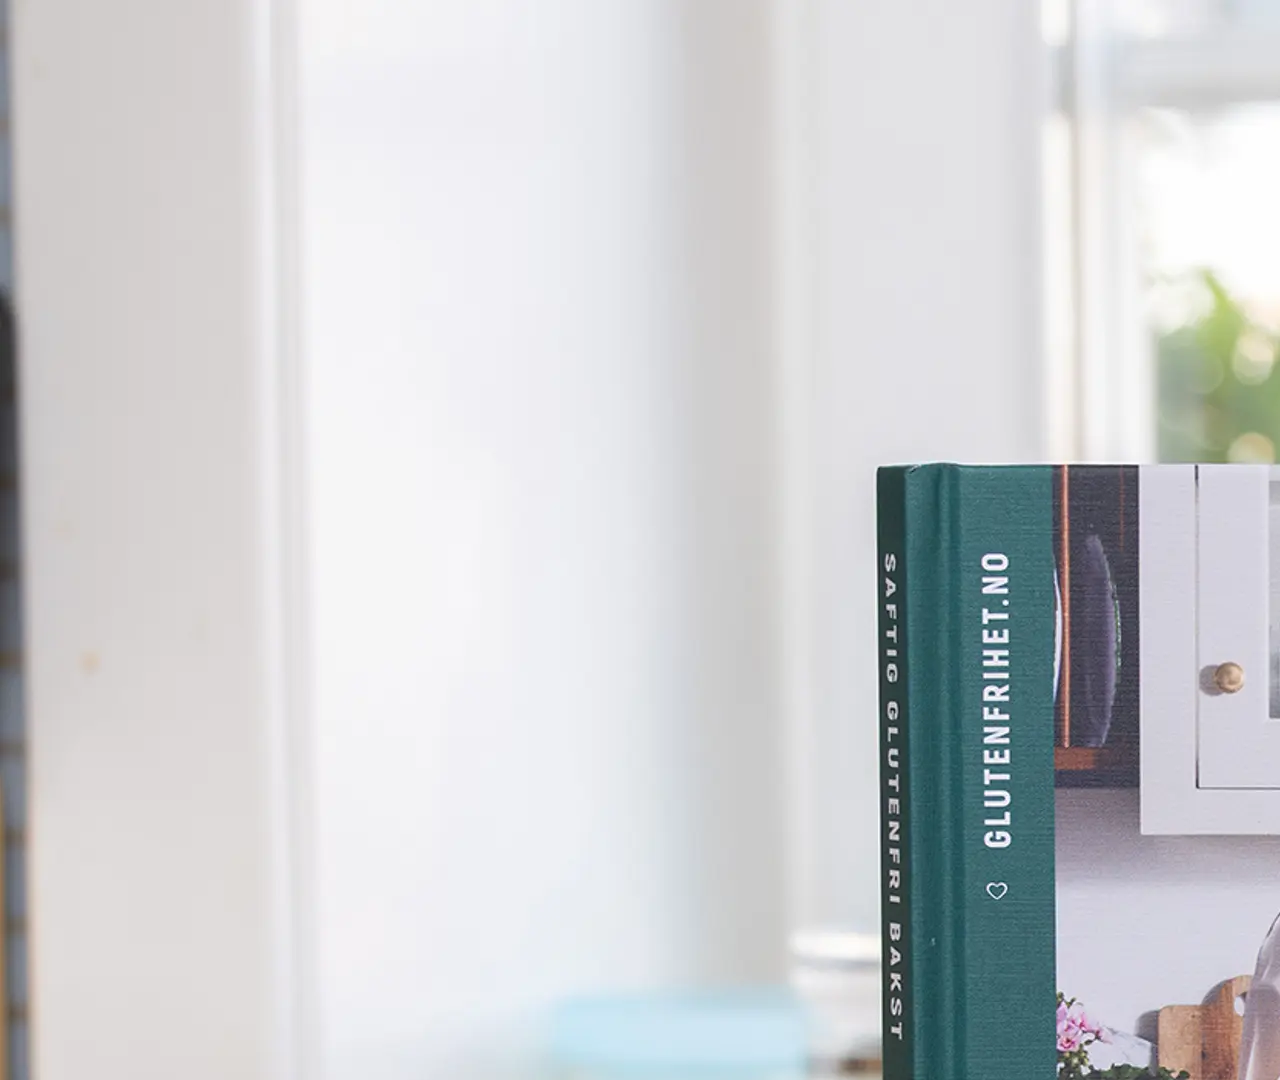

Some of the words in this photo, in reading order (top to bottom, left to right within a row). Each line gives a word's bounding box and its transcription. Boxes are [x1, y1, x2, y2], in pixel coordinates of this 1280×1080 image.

[884, 553, 899, 683] SAFTIG
[981, 552, 1011, 849] GLUTENFRIHET.NO
[886, 700, 901, 904] GLUTENFRI
[888, 921, 903, 1040] BAKST
